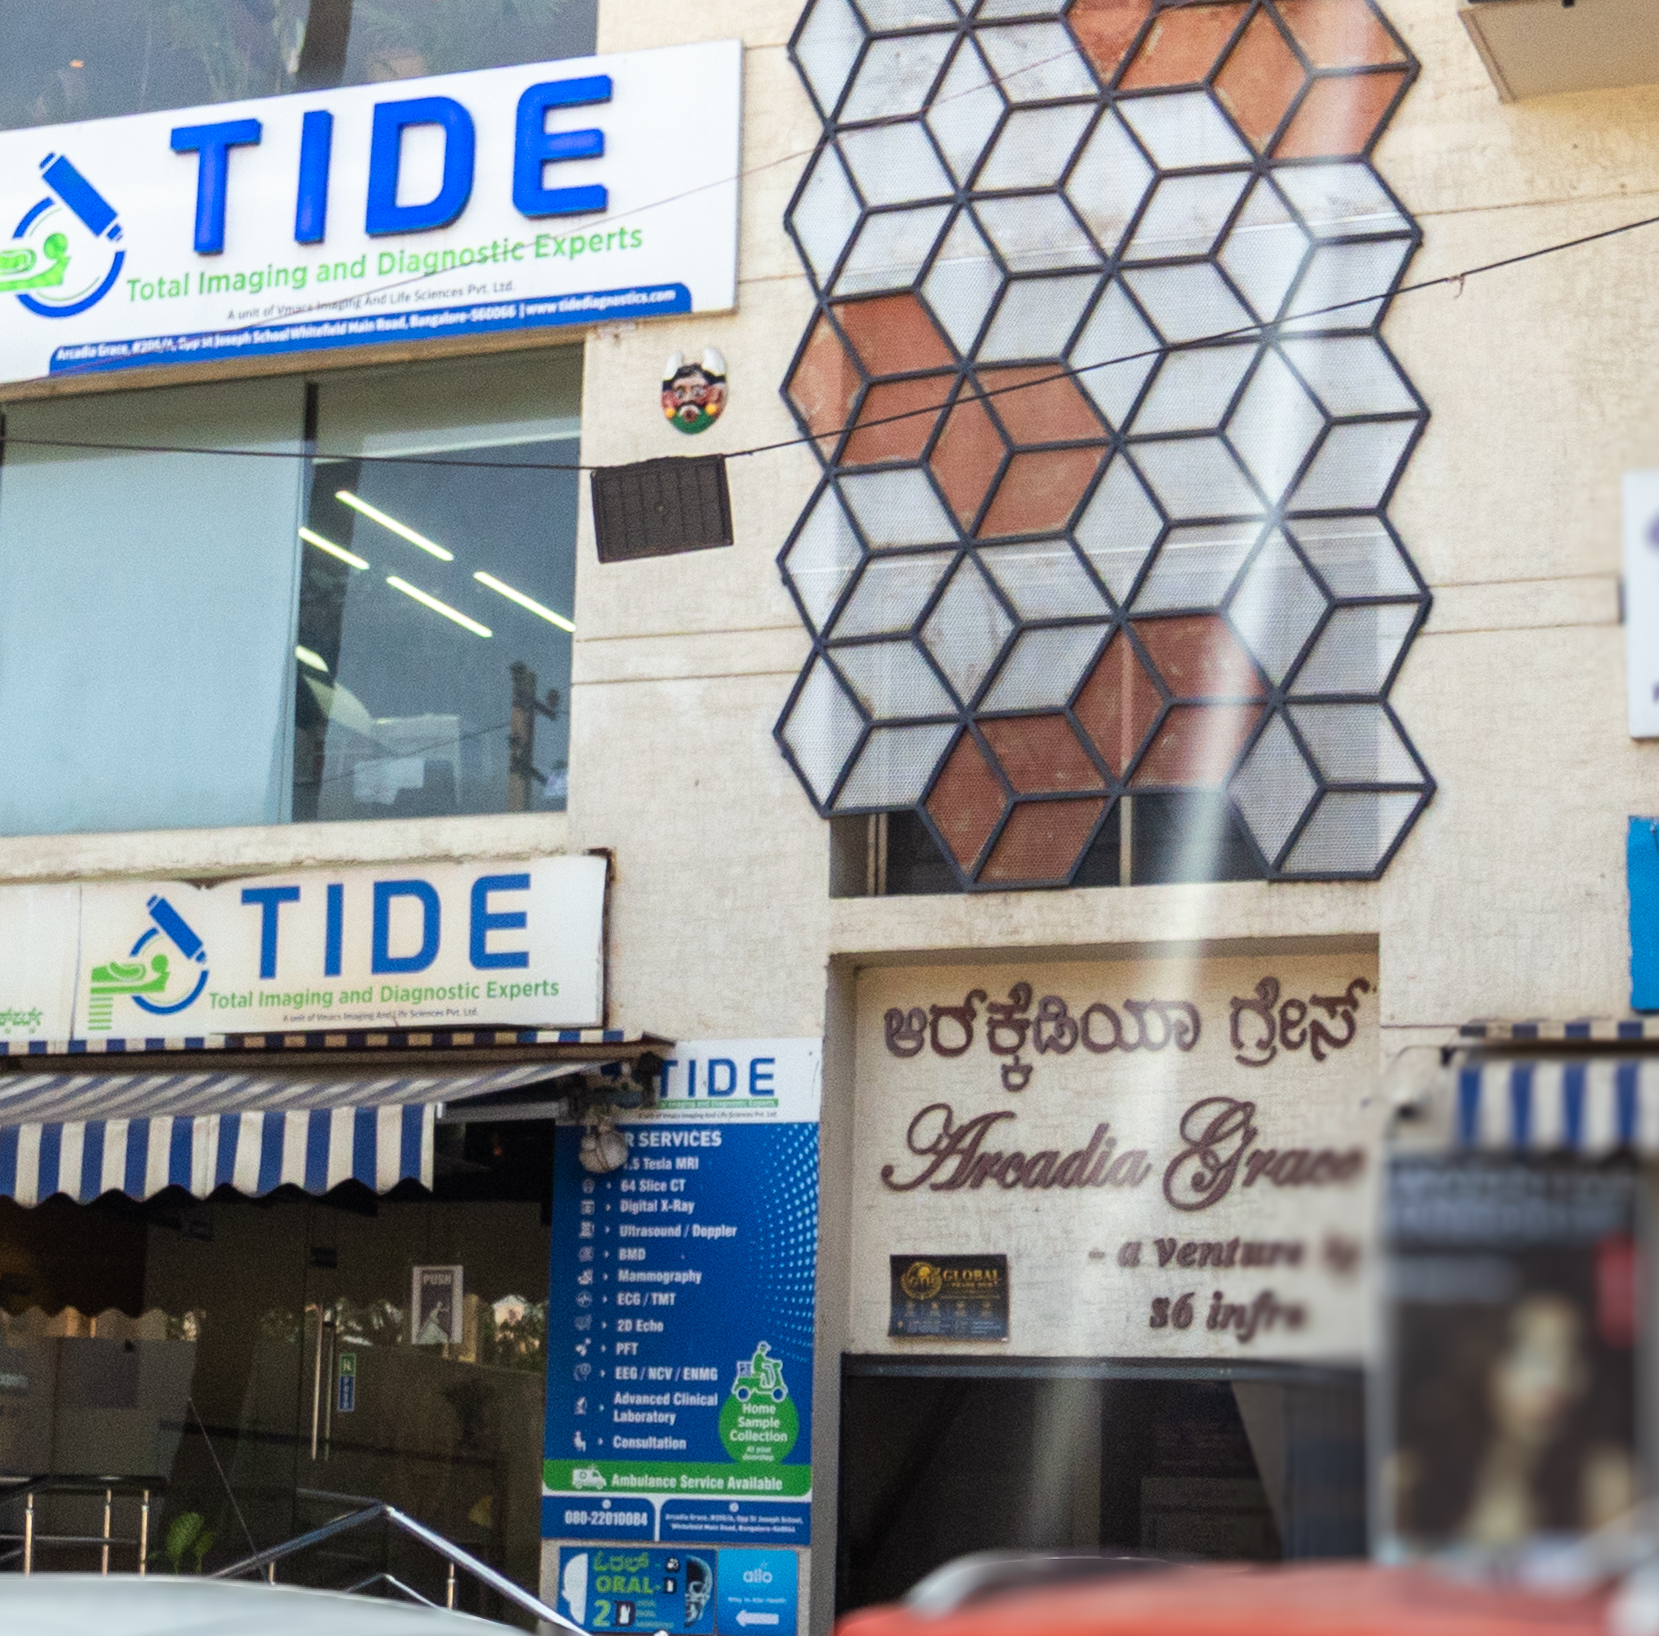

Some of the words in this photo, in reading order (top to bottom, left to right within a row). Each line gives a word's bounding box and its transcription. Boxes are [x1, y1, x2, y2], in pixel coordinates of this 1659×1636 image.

[170, 74, 613, 256] TIDE
[126, 273, 189, 303] Total
[199, 263, 308, 295] Imaging
[315, 254, 367, 283] and
[377, 238, 525, 277] Diagnostic
[534, 226, 644, 260] Experts
[238, 306, 261, 320] unit
[365, 293, 387, 306] And
[390, 291, 411, 303] Life
[414, 286, 464, 300] Sciences
[241, 873, 532, 980] TIDE
[209, 991, 254, 1010] Total
[259, 985, 334, 1009] Imaging
[339, 983, 374, 1004] and
[380, 980, 481, 1005] Diagnostic
[486, 978, 560, 1002] Experts
[659, 1057, 775, 1098] TIDE
[638, 1131, 722, 1148] SERVICES
[880, 1102, 1153, 1193] Arcadia
[1161, 1096, 1367, 1213] Grace
[643, 1157, 673, 1171] Tesla
[675, 1156, 699, 1170] MRI
[620, 1179, 636, 1192] 64
[639, 1178, 668, 1192] Slice
[670, 1178, 687, 1192] CT
[619, 1199, 658, 1215] Digital
[660, 1200, 695, 1216] X-Ray
[618, 1224, 682, 1238] Ultrasound
[692, 1224, 737, 1239] Doppler
[618, 1248, 646, 1262] BMD
[1117, 1241, 1142, 1269] a
[422, 1272, 452, 1286] PUSH
[617, 1269, 702, 1286] Mammography
[617, 1293, 641, 1306] ECG
[651, 1292, 676, 1306] TMT
[617, 1319, 634, 1333] 2D
[636, 1318, 664, 1333] Echo
[616, 1342, 638, 1356] PFT
[615, 1366, 638, 1381] EEG
[648, 1366, 673, 1381] NCV
[683, 1366, 718, 1381] ENMG
[614, 1391, 671, 1406] Advanced
[673, 1392, 718, 1407] Clinical
[613, 1408, 676, 1426] Laboratory
[742, 1403, 777, 1415] Home
[737, 1416, 780, 1430] Sample
[612, 1435, 687, 1451] Consultation
[729, 1429, 788, 1443] Collection
[611, 1474, 677, 1489] Ambulance
[680, 1475, 725, 1490] Service
[727, 1475, 783, 1491] Available
[564, 1510, 648, 1527] 080-22010084
[743, 1567, 773, 1584] allo
